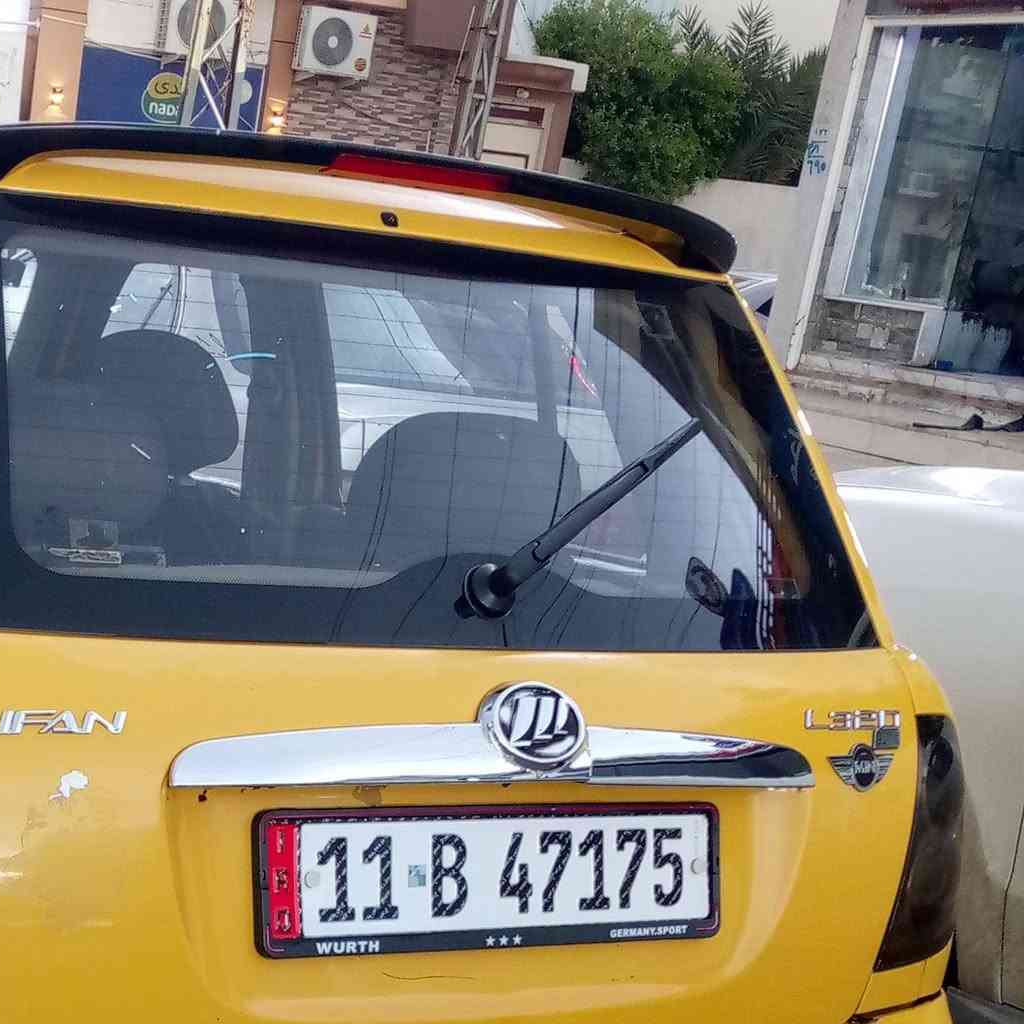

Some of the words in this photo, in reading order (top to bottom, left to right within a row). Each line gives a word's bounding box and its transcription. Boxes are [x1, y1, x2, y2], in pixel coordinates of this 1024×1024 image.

[804, 709, 900, 730] L320
[316, 835, 399, 922] 11
[431, 833, 469, 918] B
[499, 828, 685, 914] 47175
[609, 924, 689, 939] GERMANY.SPORT
[315, 939, 381, 955] WURTH
